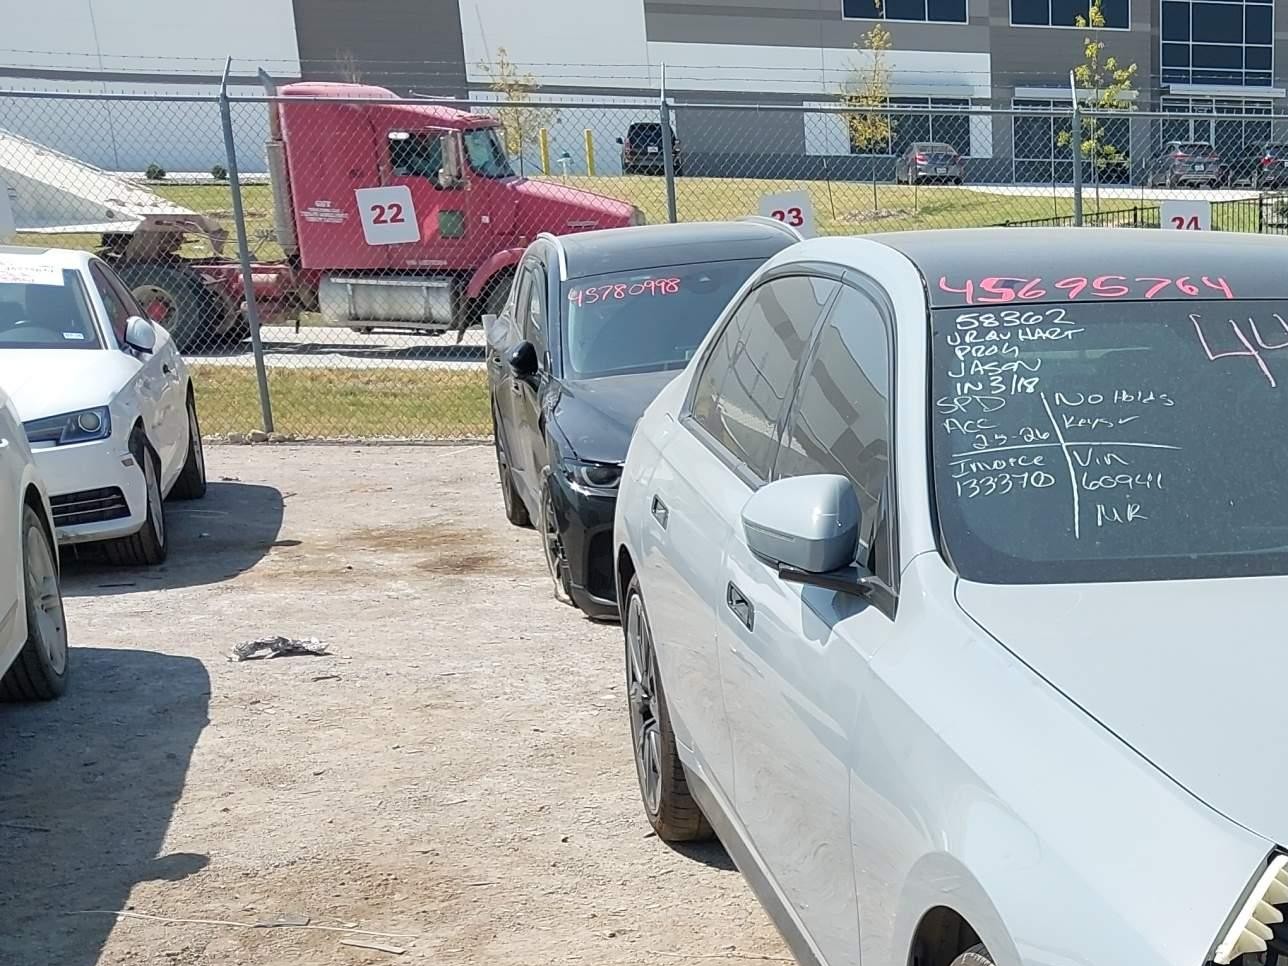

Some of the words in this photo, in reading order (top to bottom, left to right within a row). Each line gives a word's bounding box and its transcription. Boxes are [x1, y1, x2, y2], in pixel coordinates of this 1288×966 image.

[371, 204, 404, 225] 22
[567, 278, 681, 307] 45780998
[939, 276, 1233, 303] 45695764
[956, 309, 1075, 330] 58362
[948, 358, 1041, 378] JASON
[956, 381, 983, 396] IN
[989, 374, 1040, 395] 3/18
